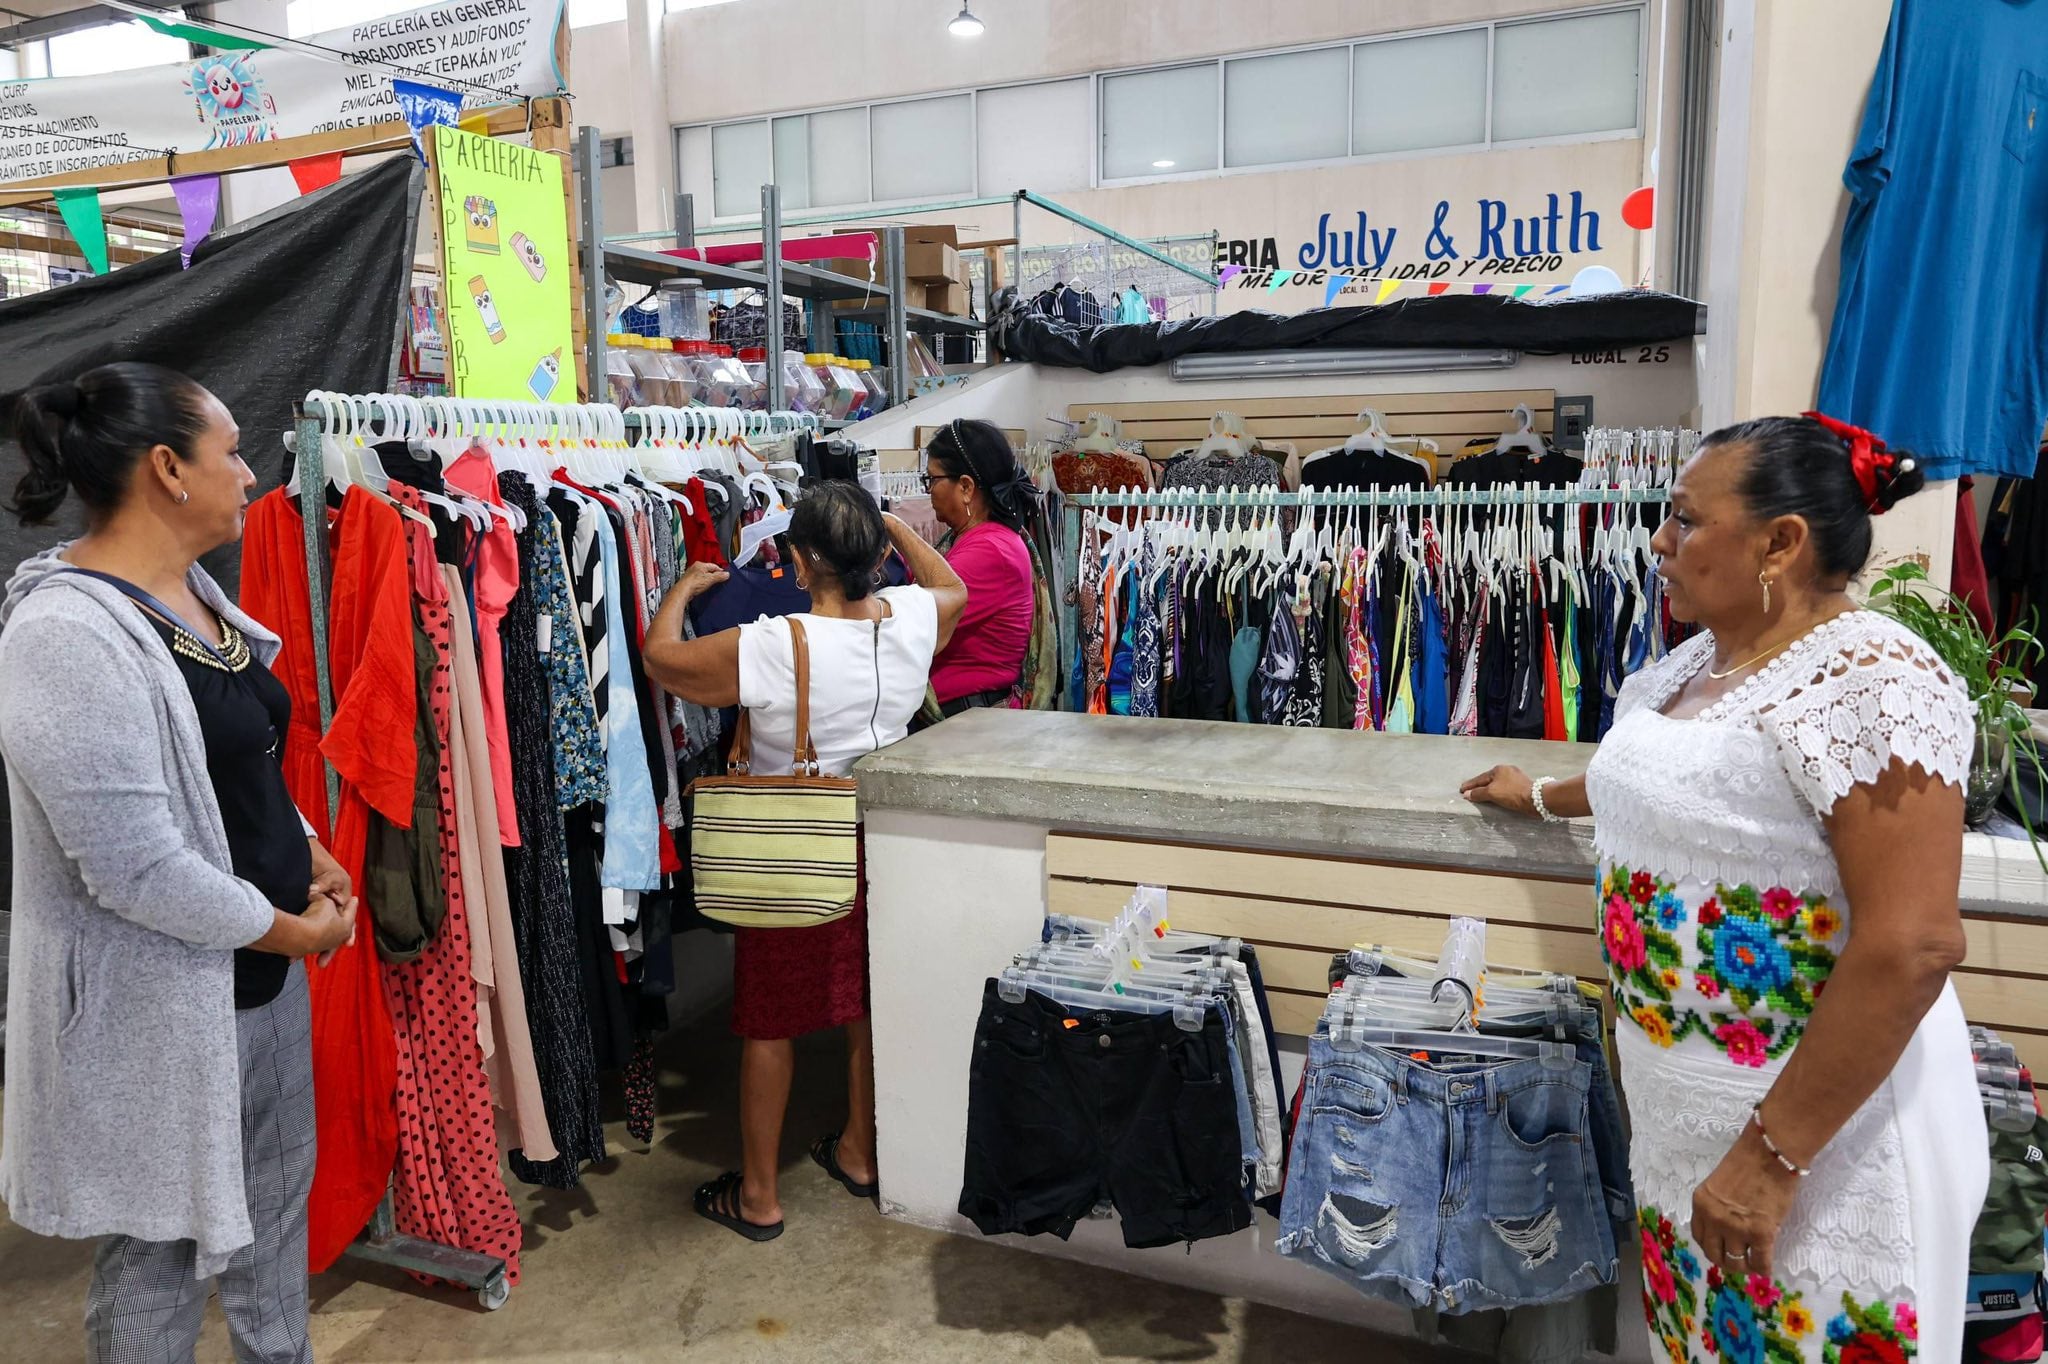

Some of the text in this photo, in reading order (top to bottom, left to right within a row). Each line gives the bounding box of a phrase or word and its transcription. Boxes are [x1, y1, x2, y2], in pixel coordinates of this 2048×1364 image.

[353, 0, 526, 42] PAPELERÍA EN GENERAL
[341, 37, 437, 66] CARGADORES
[438, 35, 447, 49] Y
[345, 73, 377, 91] MIEL
[414, 61, 431, 76] DE
[435, 48, 496, 75] TEPAKÁN
[3, 83, 28, 99] CURP
[20, 124, 33, 137] DE
[37, 115, 99, 136] NACIMIENTO
[220, 114, 260, 127] PAPELERIA
[312, 118, 354, 134] COPIAS
[36, 141, 49, 154] DE
[53, 132, 128, 153] DOCUMENTOS
[438, 125, 543, 183] PAPELERIA
[40, 160, 53, 175] DE
[56, 151, 125, 172] INSCRIPCIÓN
[1299, 210, 1397, 269] July
[1425, 200, 1460, 261] &
[1472, 190, 1603, 261] Ruth
[1458, 260, 1477, 277] Y
[1479, 255, 1563, 276] PRECIO
[1339, 286, 1358, 295] LOCAL
[1571, 346, 1670, 365] LOCAL 25
[1983, 1293, 2015, 1306] JUSTICE
